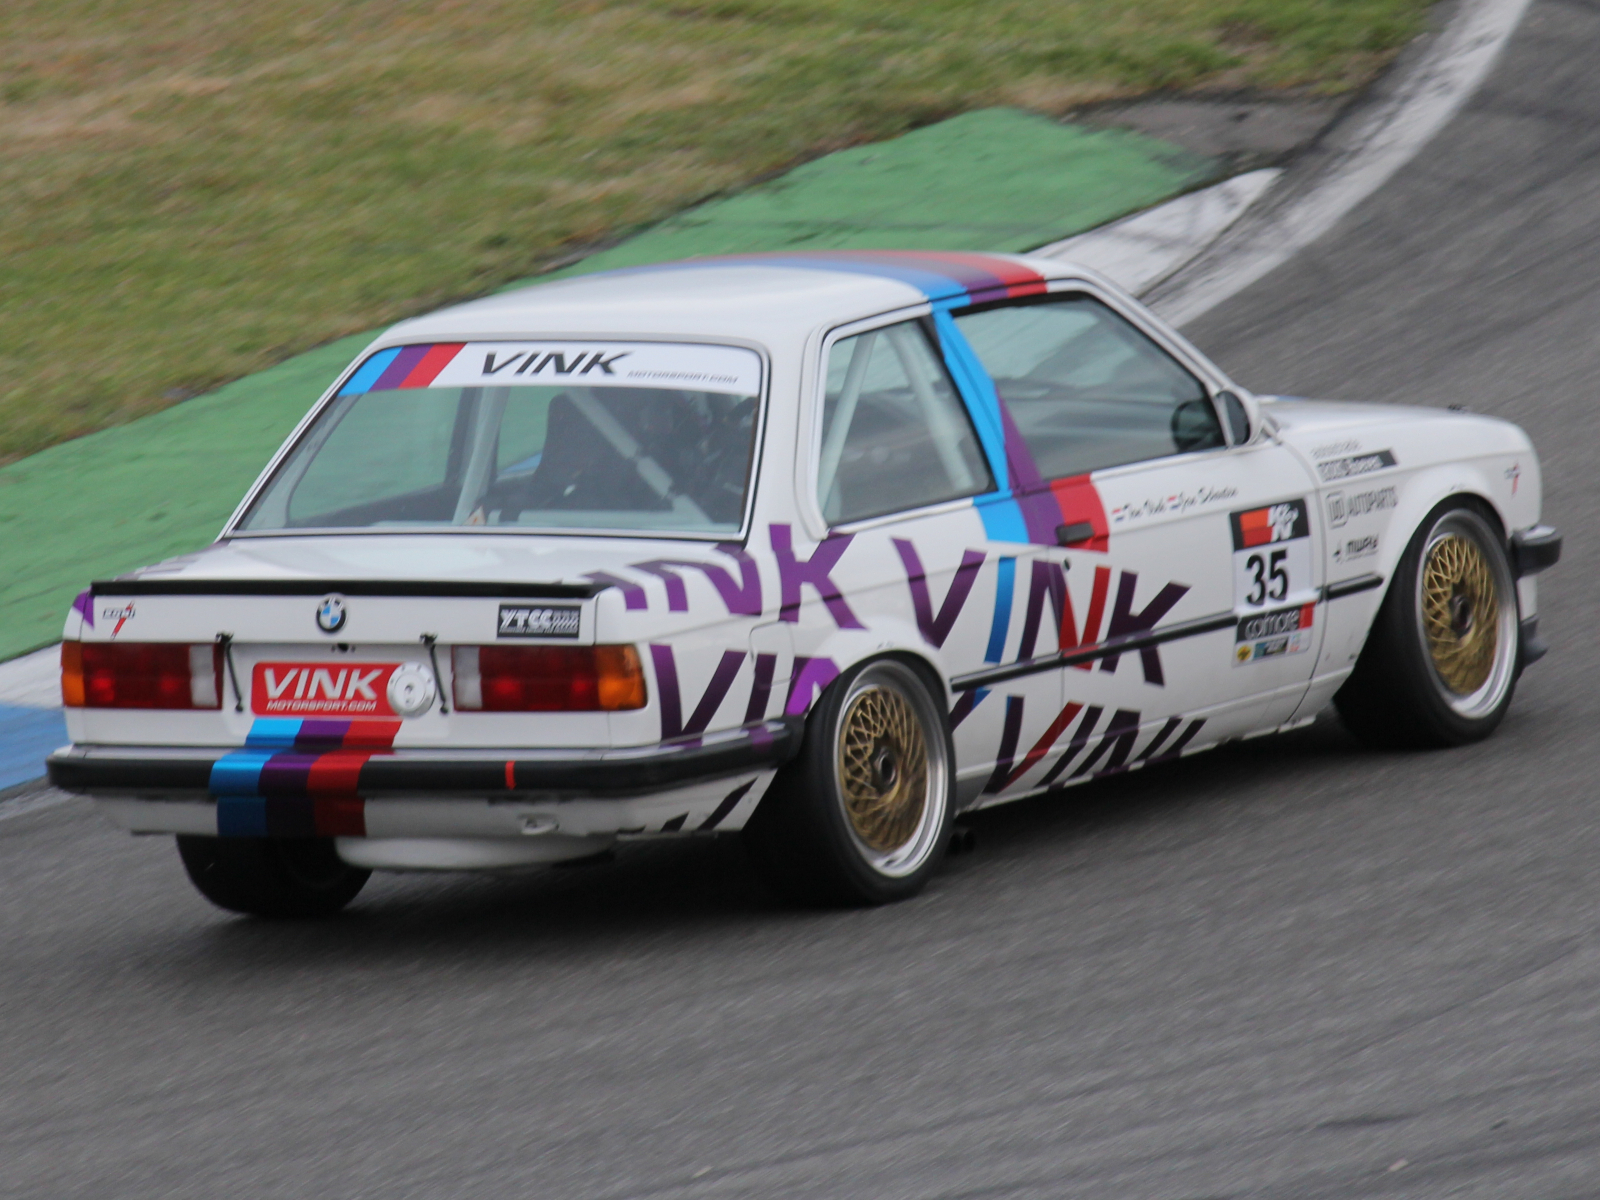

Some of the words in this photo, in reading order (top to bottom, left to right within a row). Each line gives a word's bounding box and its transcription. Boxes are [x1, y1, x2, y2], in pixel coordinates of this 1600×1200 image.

[481, 351, 633, 377] VINK
[627, 370, 739, 385] MOTORSPORT.COM
[1245, 549, 1289, 607] 35
[890, 536, 1192, 687] VINK
[263, 668, 383, 701] VINK
[265, 700, 378, 713] MOTORSPORT.COM
